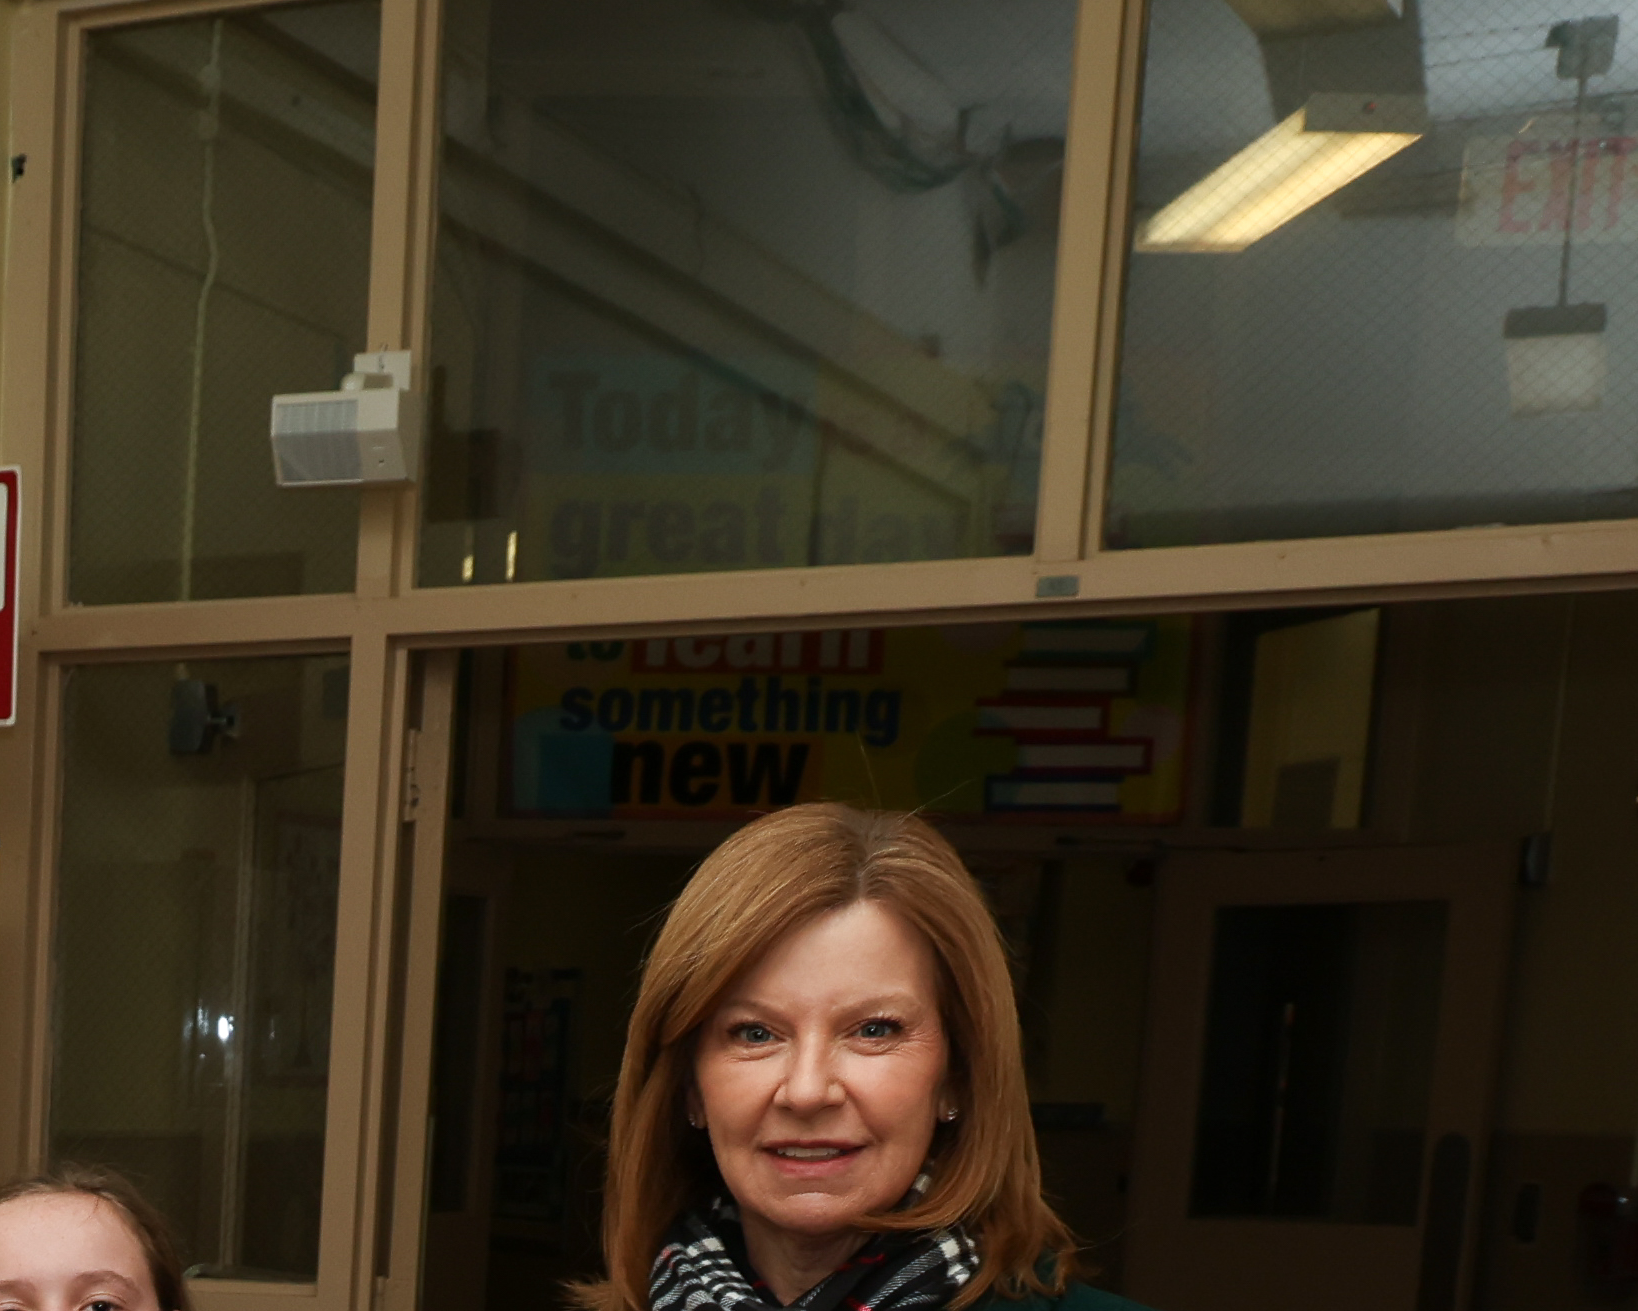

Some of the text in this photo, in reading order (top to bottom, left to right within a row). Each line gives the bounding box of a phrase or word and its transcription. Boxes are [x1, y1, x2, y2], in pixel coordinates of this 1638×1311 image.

[547, 370, 813, 469] Today
[549, 488, 785, 579] great
[559, 676, 901, 748] something
[610, 740, 810, 806] new
